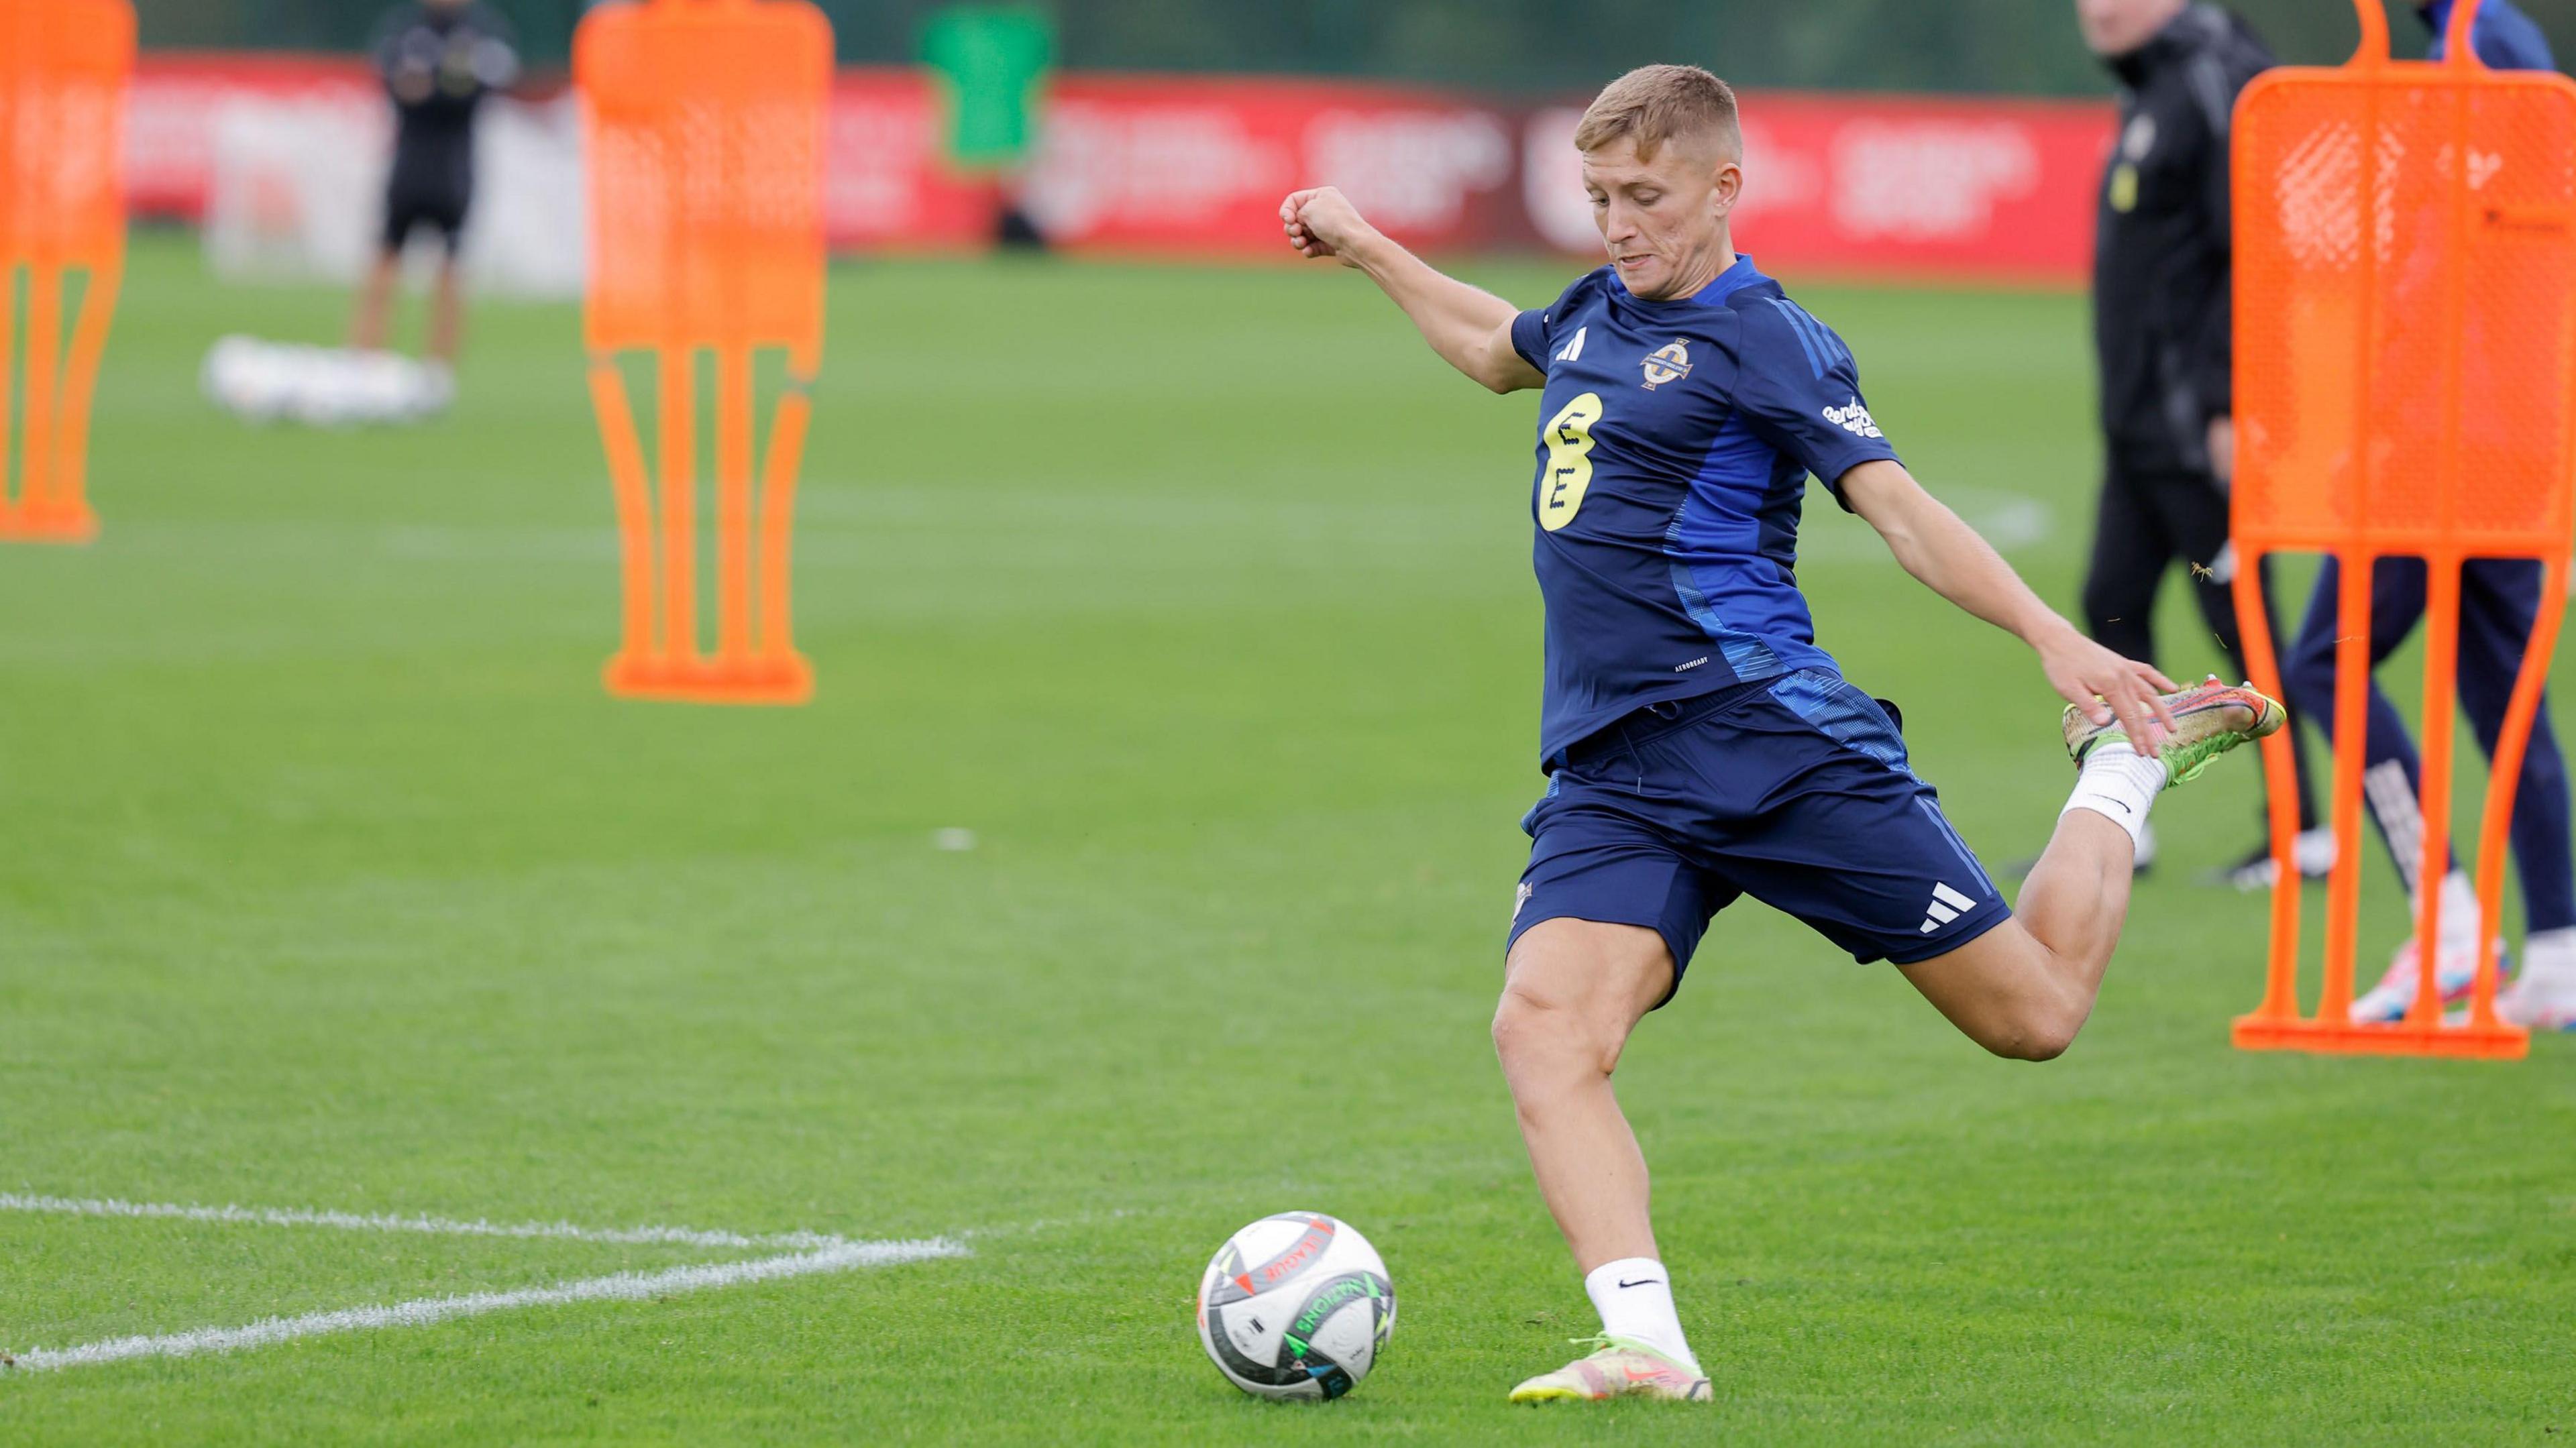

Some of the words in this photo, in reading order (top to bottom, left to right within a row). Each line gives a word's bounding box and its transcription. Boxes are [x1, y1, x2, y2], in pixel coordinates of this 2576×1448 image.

[1675, 656, 1708, 673] AEROREADY
[1263, 1235, 1326, 1284] LEAGUE
[1295, 1278, 1364, 1333] NATIONS
